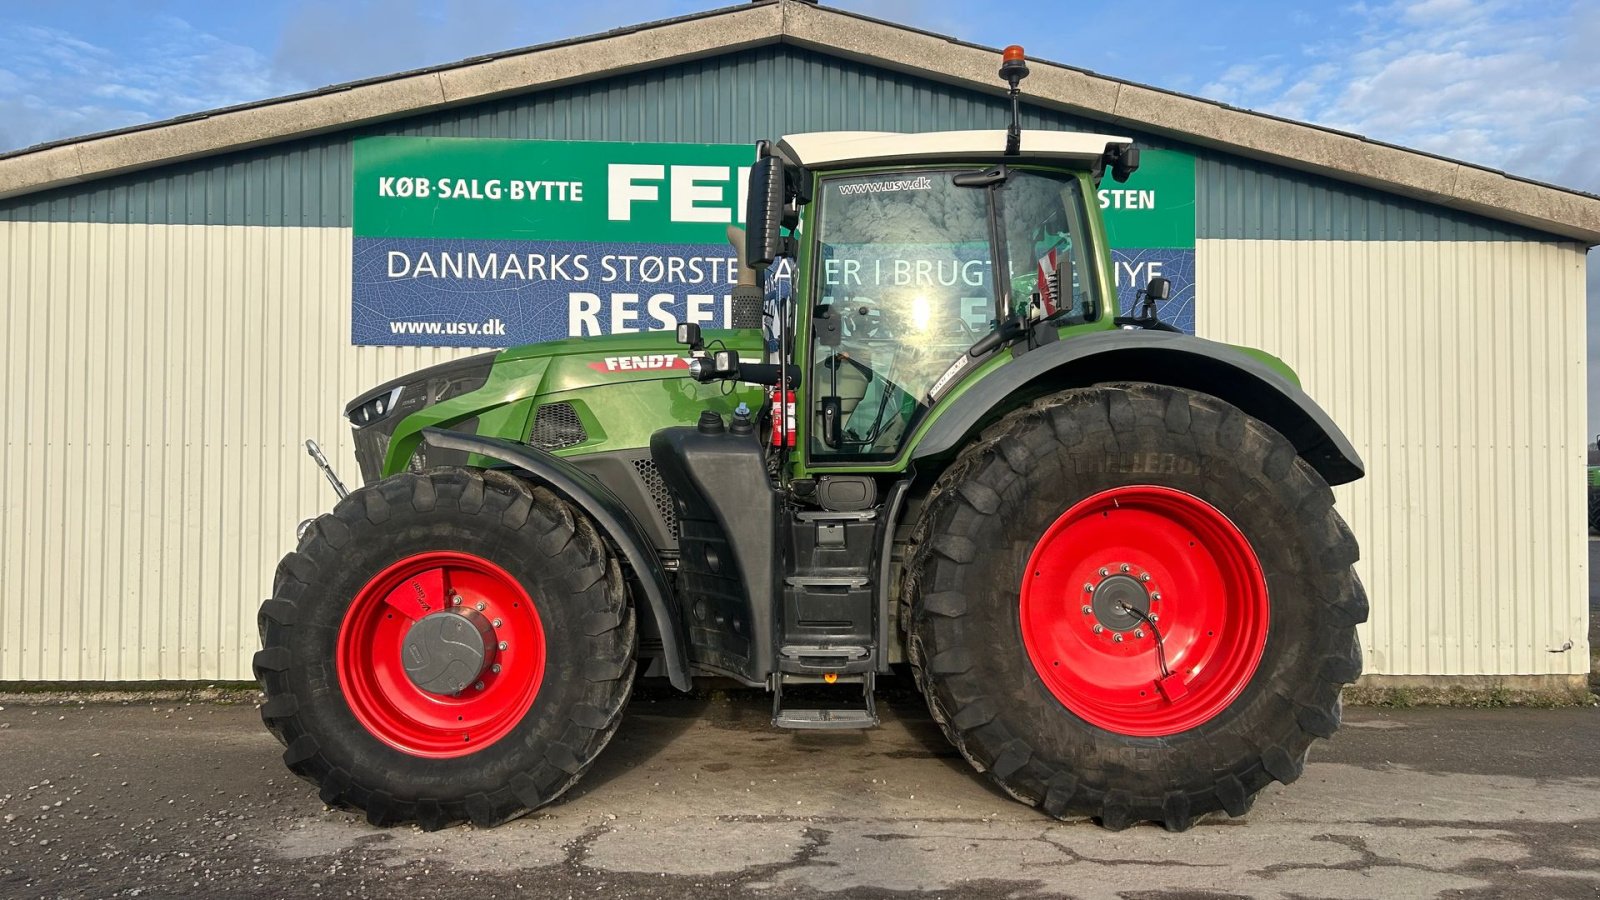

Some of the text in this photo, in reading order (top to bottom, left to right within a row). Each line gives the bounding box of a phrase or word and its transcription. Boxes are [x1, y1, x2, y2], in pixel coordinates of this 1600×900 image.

[839, 177, 931, 194] www.usv.dk
[387, 251, 589, 281] DANMARKS
[602, 255, 738, 284] STØRSTE
[390, 319, 506, 336] www.usv.dk
[604, 354, 679, 371] FENDT
